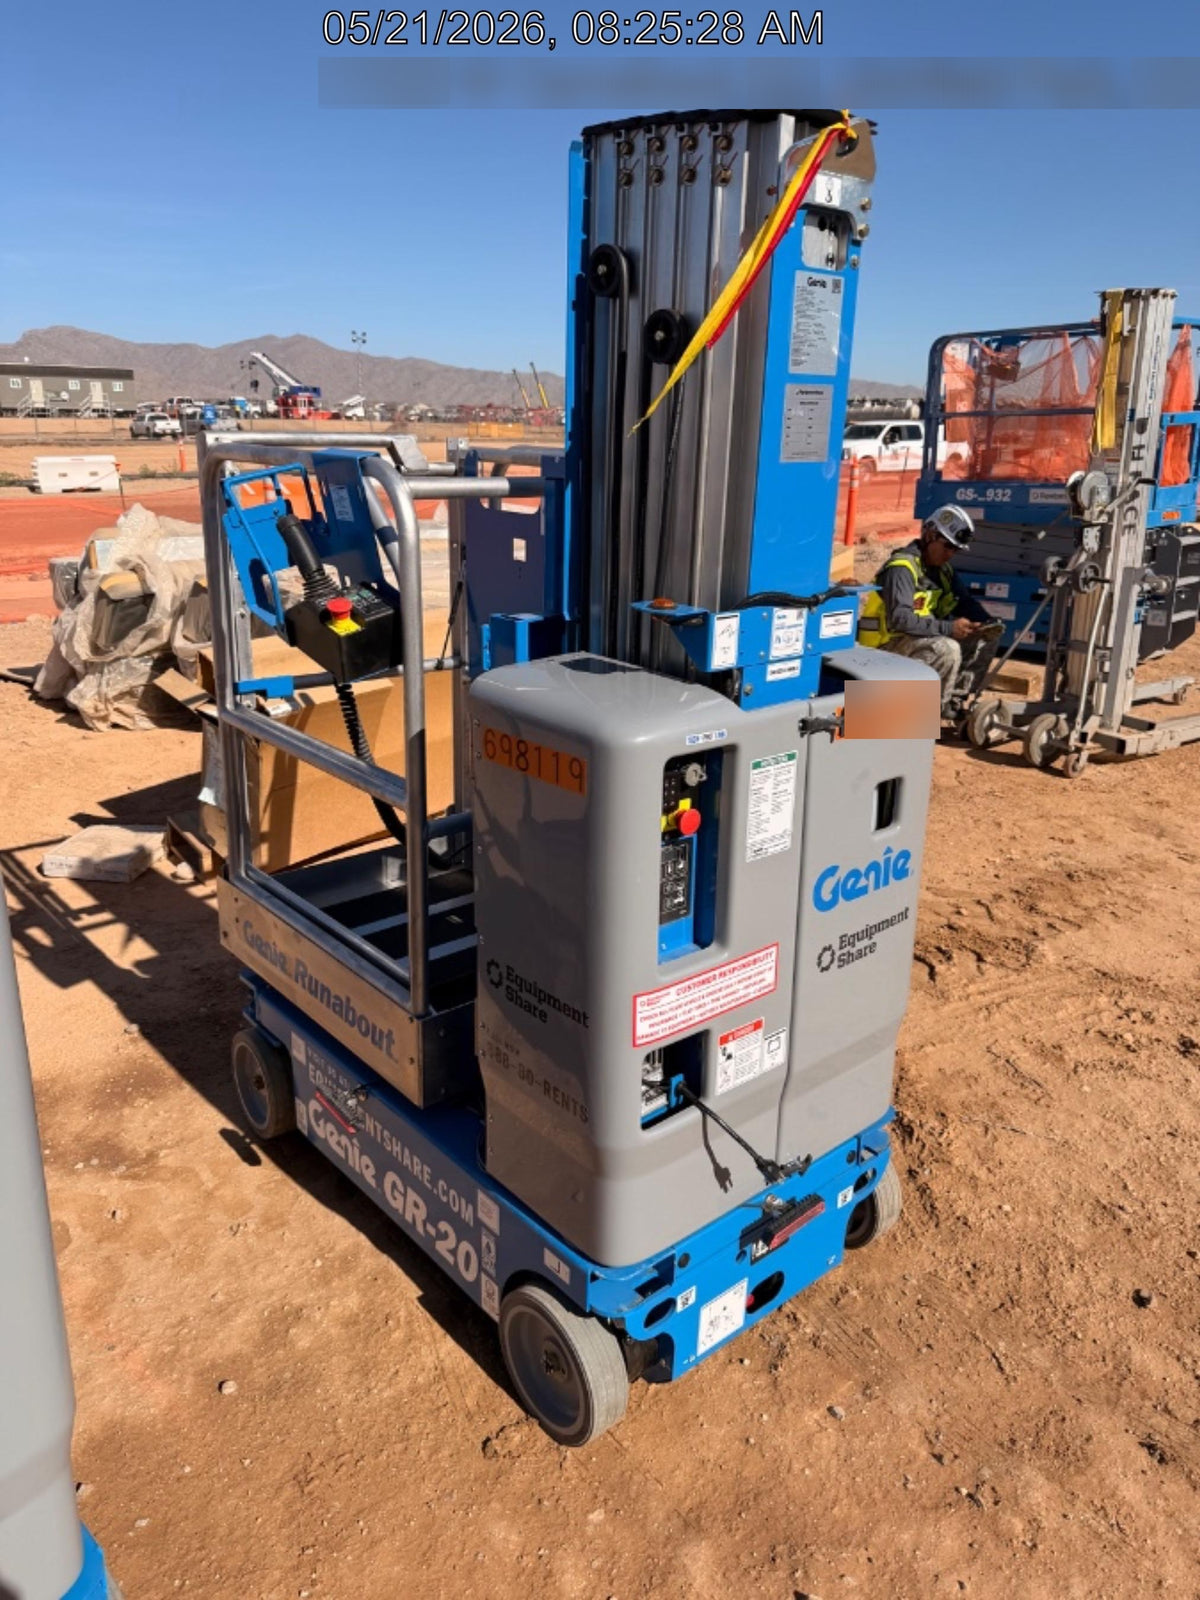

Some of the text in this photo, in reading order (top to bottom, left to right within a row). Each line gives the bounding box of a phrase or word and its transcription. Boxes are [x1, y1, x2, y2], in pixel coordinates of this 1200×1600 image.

[956, 488, 1012, 502] GS-932
[484, 728, 583, 793] 698119
[812, 846, 912, 912] Genie
[838, 907, 909, 950] Equipment
[837, 942, 877, 969] Share
[243, 920, 396, 1057] Genie Runabout
[505, 965, 589, 1029] Equipment
[505, 985, 548, 1023] Share
[676, 974, 718, 996] CUSTOMER
[309, 1099, 479, 1282] Genie GR-20
